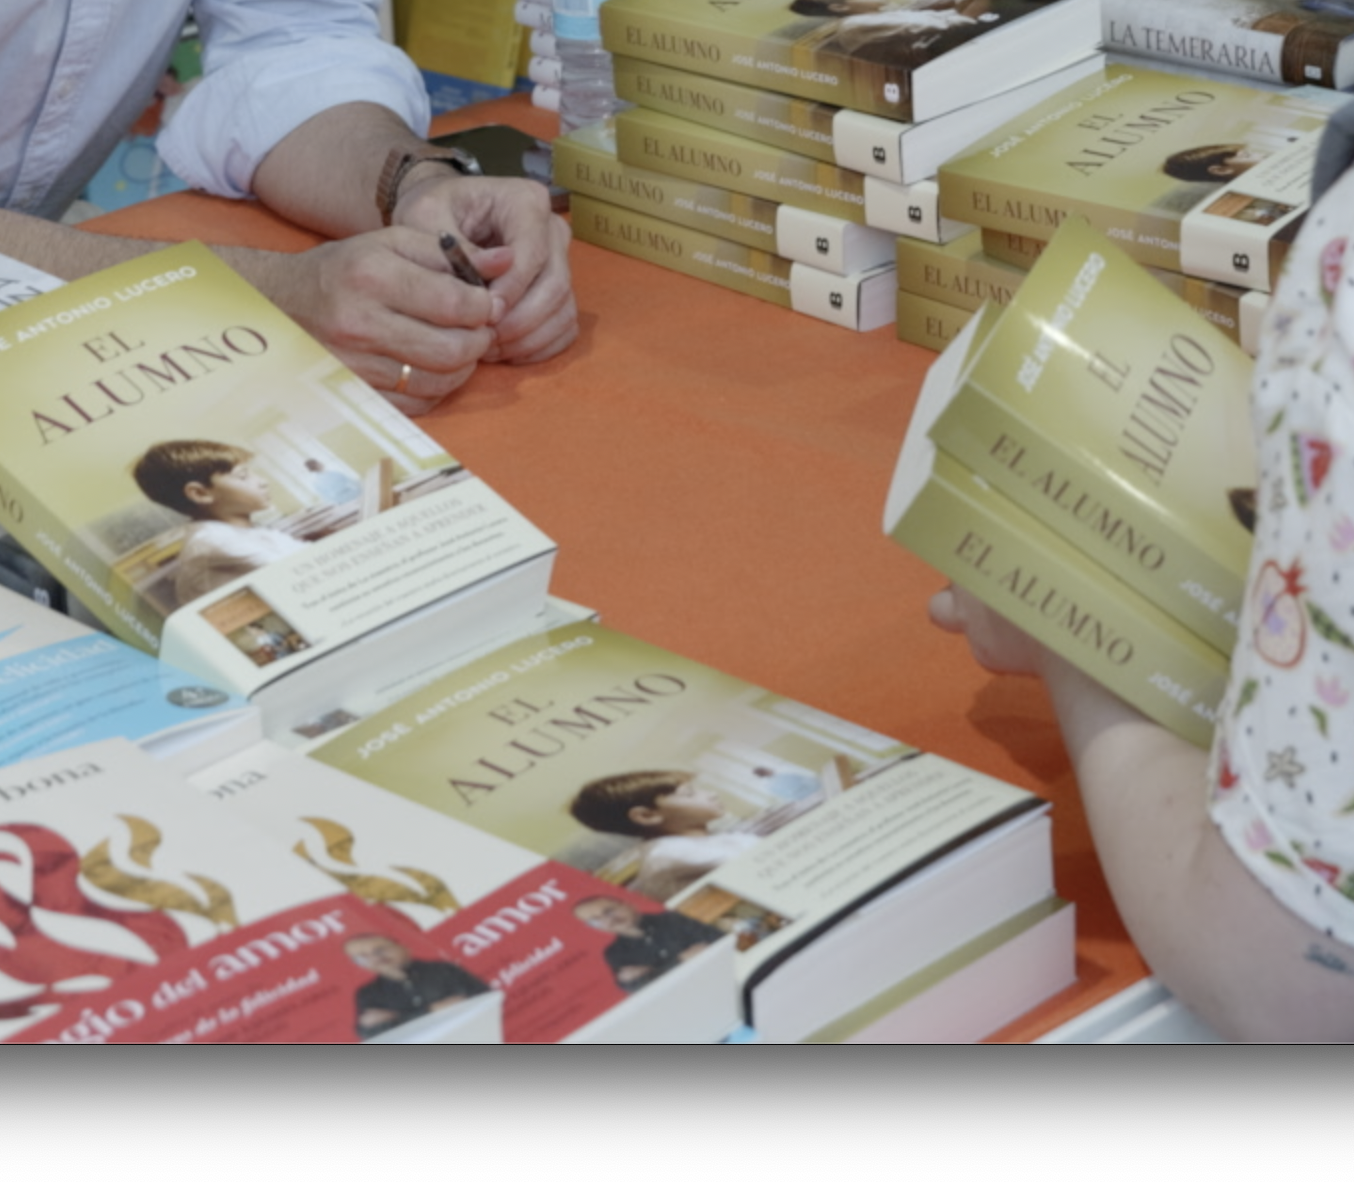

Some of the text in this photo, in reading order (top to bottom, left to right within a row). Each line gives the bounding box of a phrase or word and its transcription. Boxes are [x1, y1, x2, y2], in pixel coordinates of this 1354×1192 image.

[625, 24, 722, 64] EL ALUMNO
[1109, 19, 1277, 76] LA TEMERARIA
[636, 74, 725, 117] EL ALUMNO
[1076, 108, 1126, 134] EL
[643, 136, 743, 178] EL ALUMNO
[1065, 88, 1219, 179] ALUMNO
[574, 162, 665, 206] EL ALUMNO
[593, 212, 684, 258] EL ALUMNO
[15, 293, 115, 345] ANTONIO
[115, 264, 199, 306] LUCERO
[925, 315, 949, 339] EL
[77, 323, 147, 367] EL
[1086, 350, 1133, 393] EL
[28, 323, 271, 448] ALUMNO
[1117, 332, 1217, 488] ALUMNO
[987, 431, 1167, 575] EL ALUMNO
[63, 556, 115, 606] ANTONIO
[114, 603, 161, 650] LUCERO
[952, 530, 1136, 668] EL ALUMNO
[355, 633, 595, 760] JOSÉ ANTONIO LUCERO
[486, 695, 557, 729] EL
[446, 671, 690, 810] ALUMNO
[451, 876, 570, 958] amor
[151, 907, 347, 1012] del amor
[497, 936, 566, 987] felicidad
